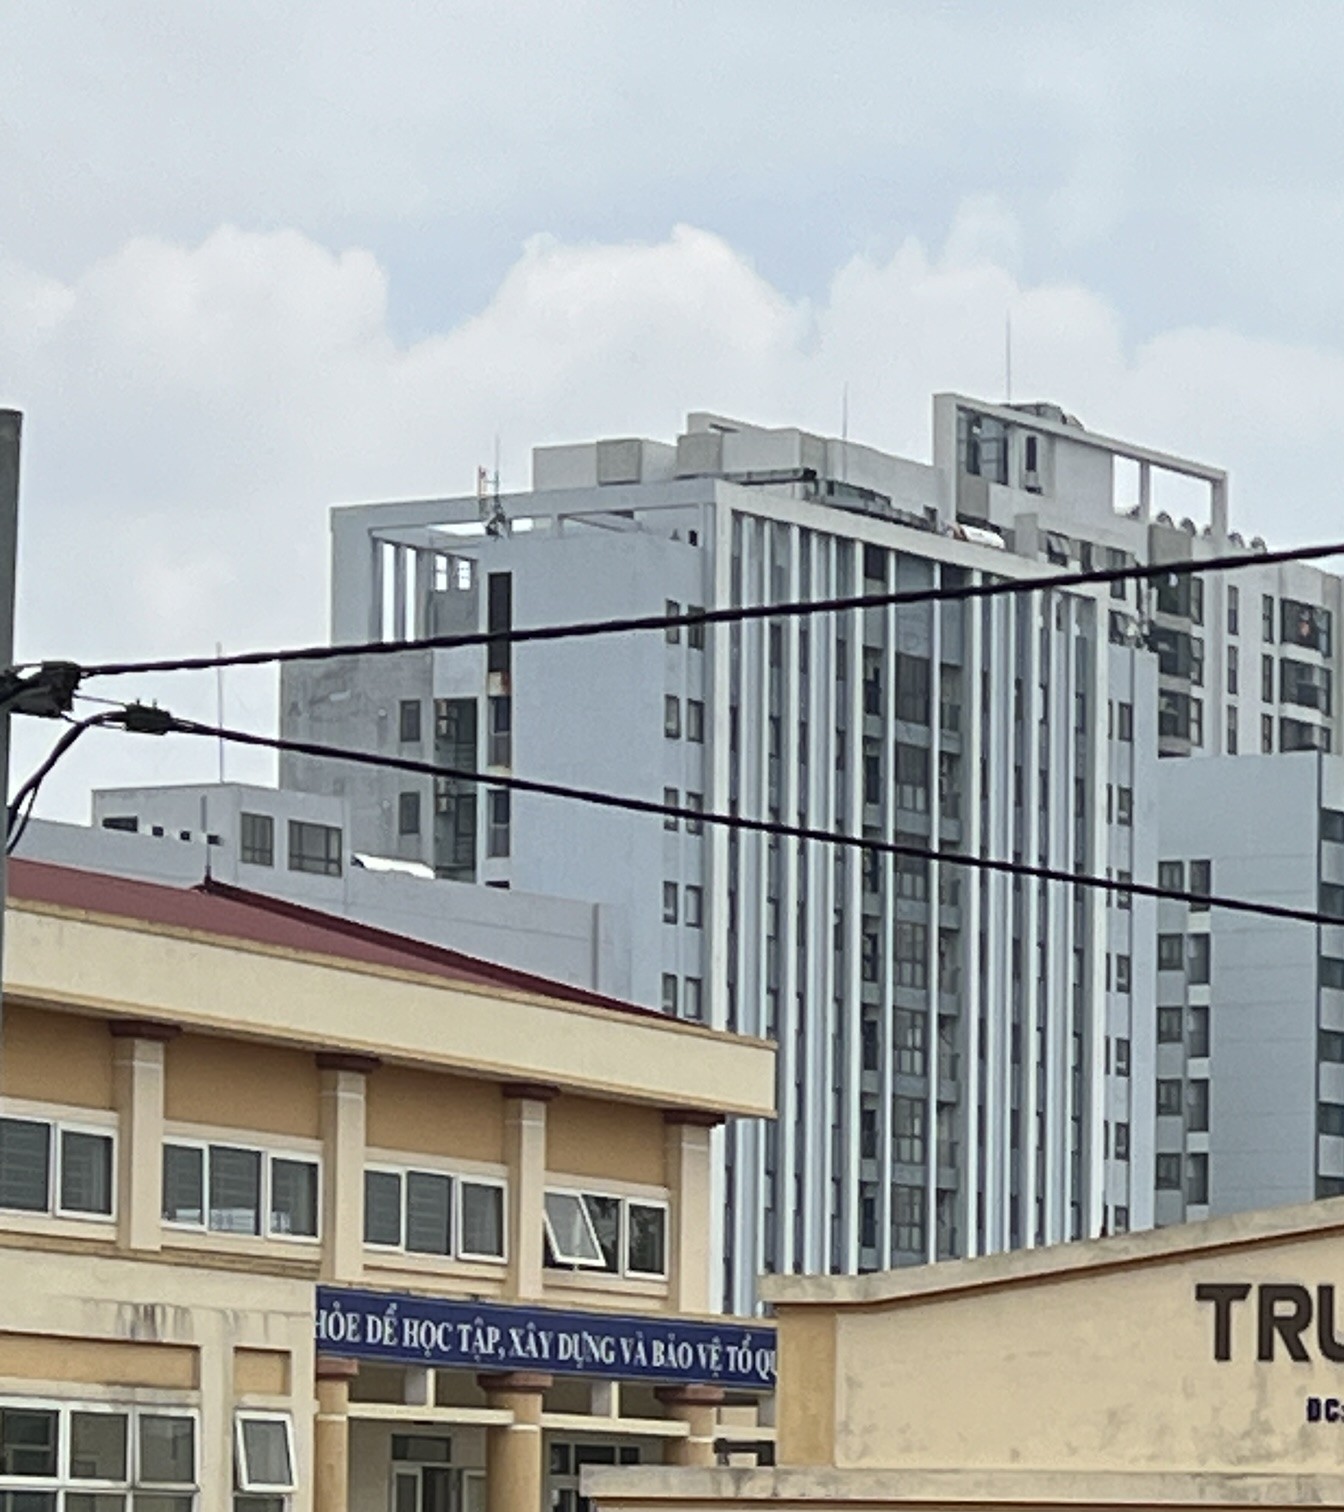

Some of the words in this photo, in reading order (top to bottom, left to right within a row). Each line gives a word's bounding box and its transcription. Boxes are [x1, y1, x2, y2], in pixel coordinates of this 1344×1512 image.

[402, 1317, 452, 1358] HỌC
[457, 1316, 505, 1362] TẬP,
[509, 1321, 554, 1360] XÂY
[558, 1331, 616, 1369] DỰNG
[620, 1331, 648, 1368] VÀ
[652, 1333, 694, 1369] BẢO
[697, 1336, 723, 1378] VỆ
[727, 1333, 753, 1374] TỔ
